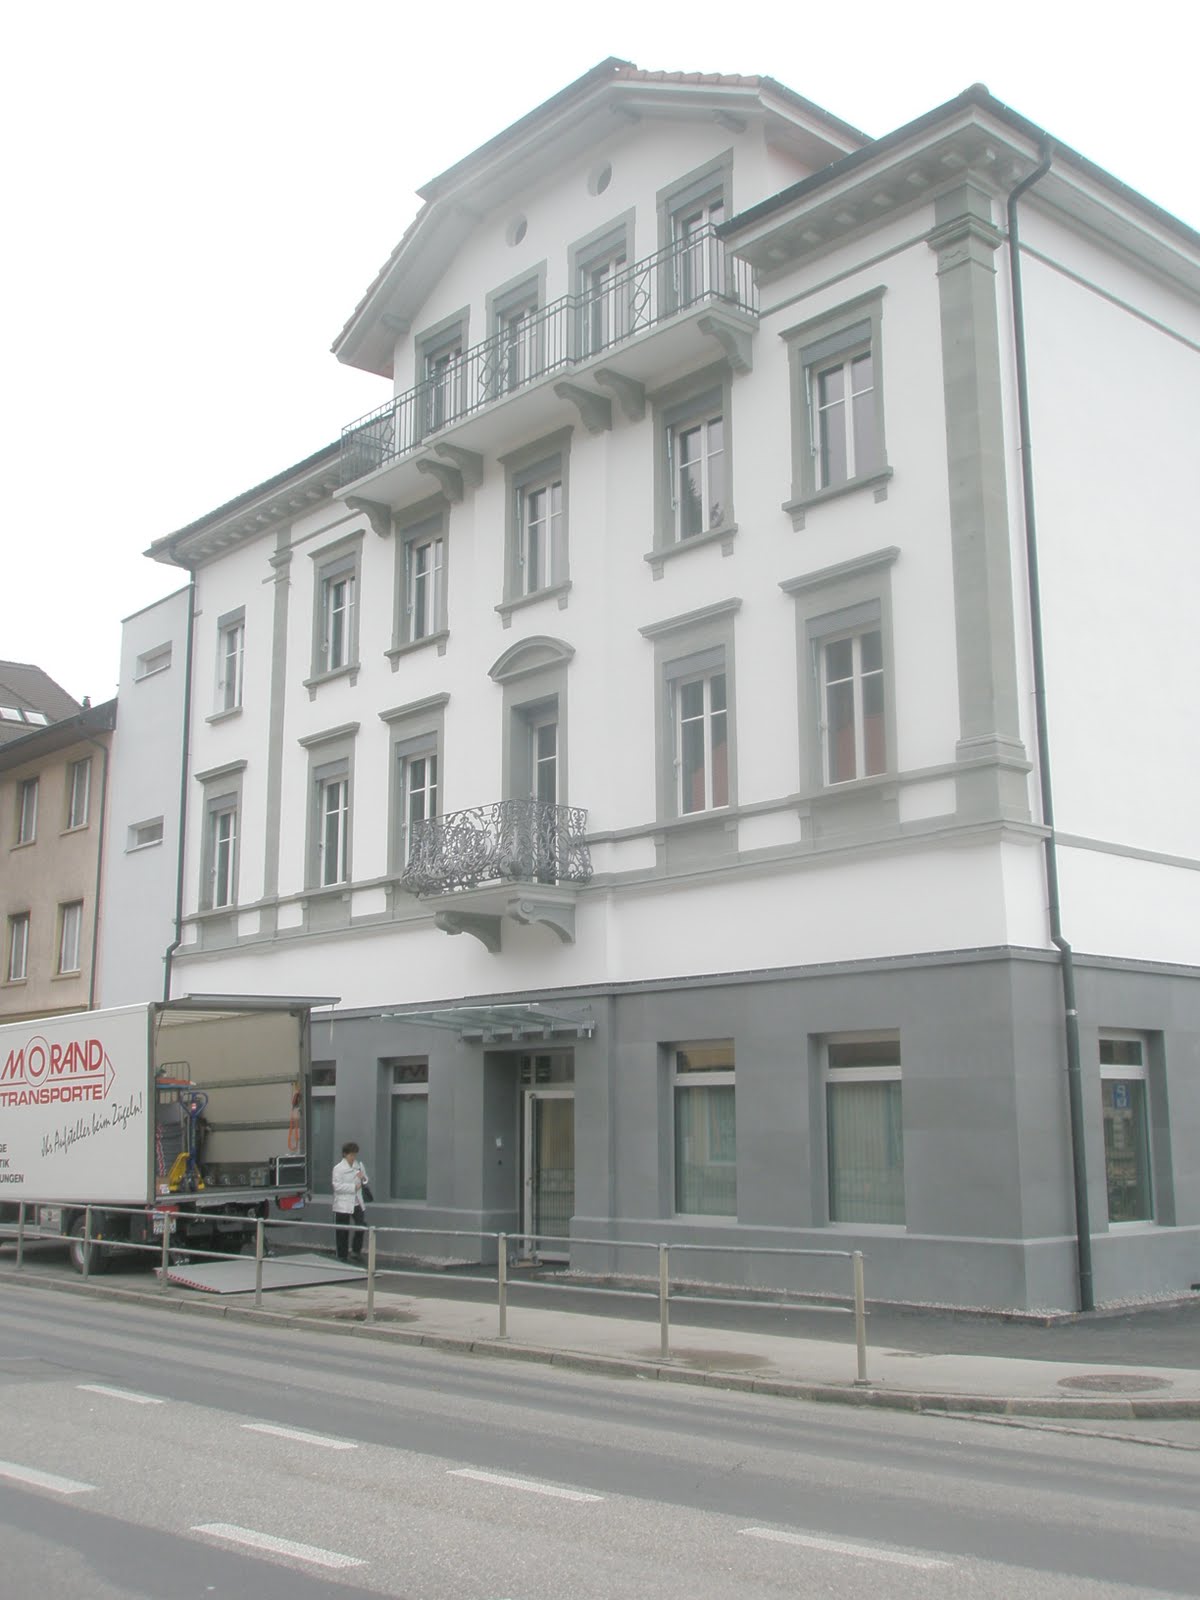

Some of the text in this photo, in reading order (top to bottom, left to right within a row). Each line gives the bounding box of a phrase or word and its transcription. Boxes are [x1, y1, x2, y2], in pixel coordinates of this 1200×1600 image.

[1, 1039, 104, 1080] MORAND
[0, 1084, 102, 1107] TRANSPORTE
[54, 1118, 91, 1154] Aufsteller
[92, 1113, 110, 1135] beim
[112, 1092, 143, 1130] Zügeln!
